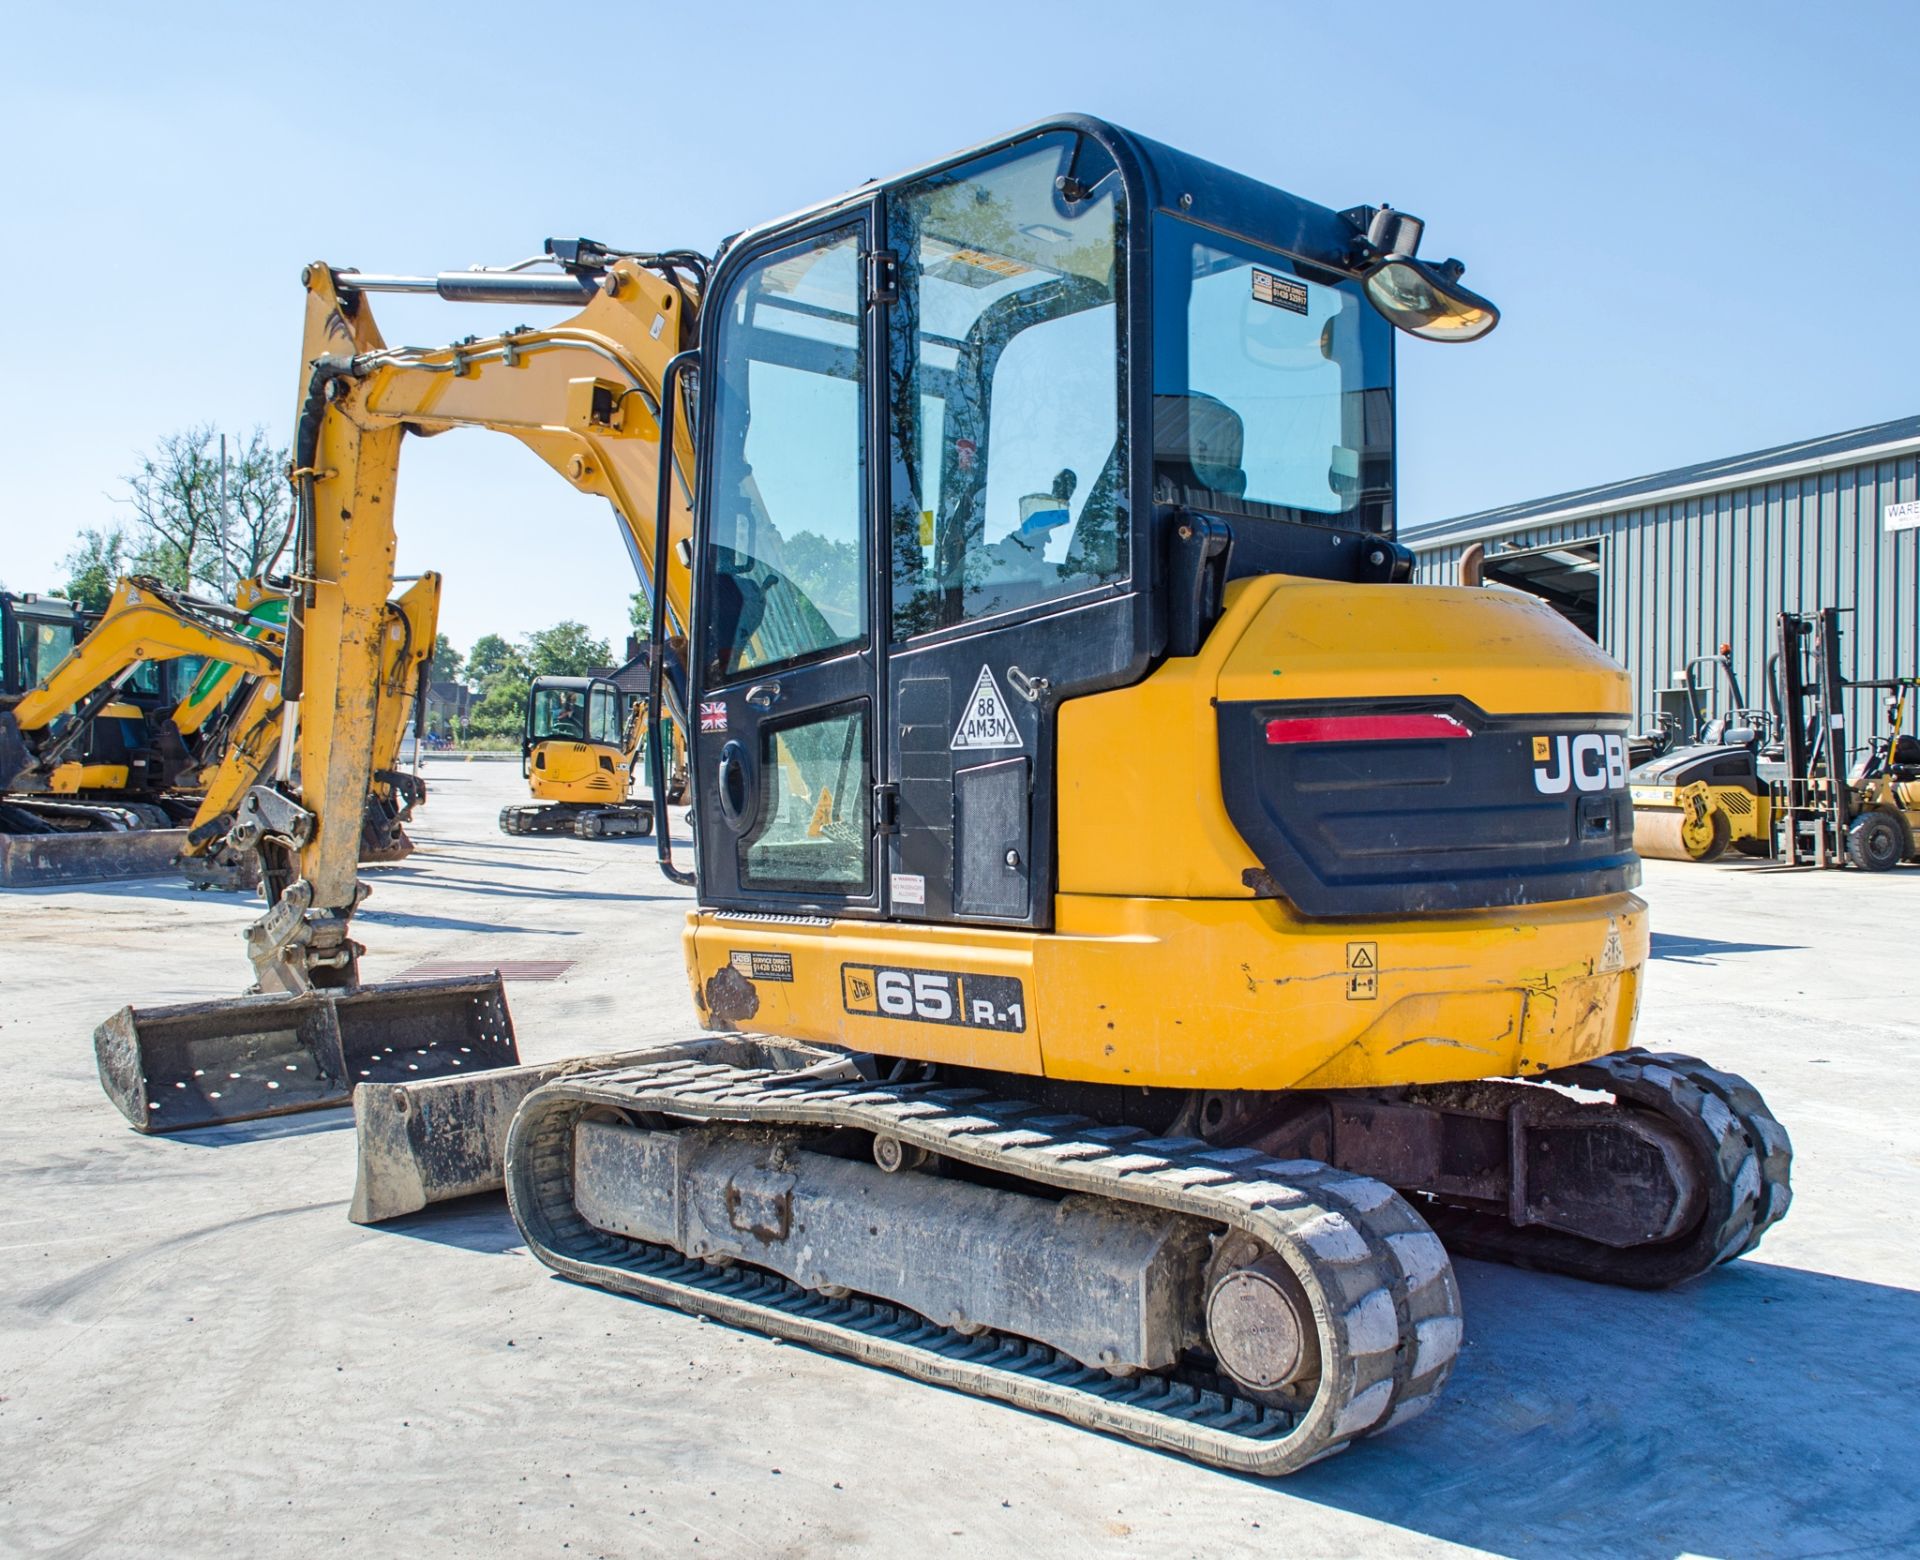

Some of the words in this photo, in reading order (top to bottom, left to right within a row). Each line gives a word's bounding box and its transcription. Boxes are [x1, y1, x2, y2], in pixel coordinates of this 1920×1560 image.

[1254, 272, 1271, 287] JCB
[978, 698, 995, 717] 88
[967, 718, 1006, 738] AM3N
[1534, 734, 1625, 794] JCB
[733, 953, 750, 963] JCB
[772, 958, 790, 966] DIRECT
[852, 979, 870, 998] JCB
[877, 971, 952, 1020] 65
[972, 1000, 1023, 1028] R-1
